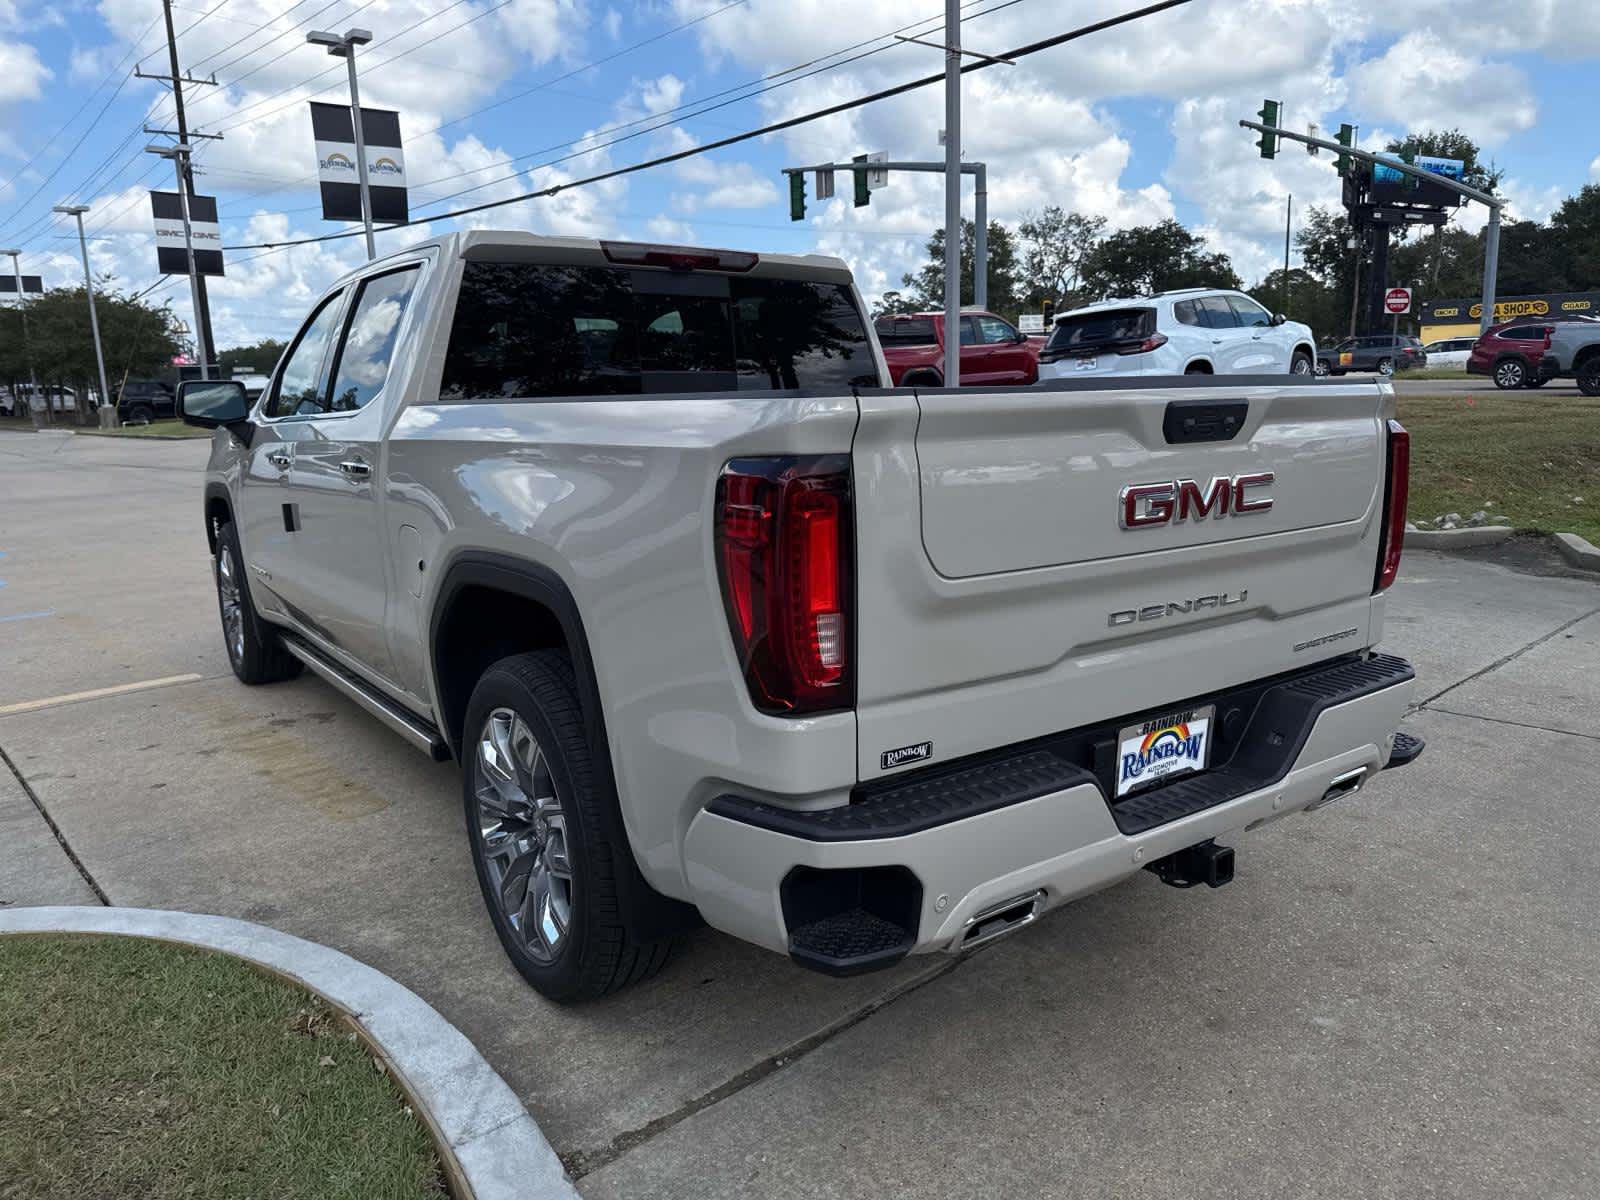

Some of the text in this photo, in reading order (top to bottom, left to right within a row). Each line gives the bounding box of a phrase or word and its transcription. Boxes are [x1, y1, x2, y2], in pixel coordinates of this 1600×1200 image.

[156, 229, 185, 238] GMC
[192, 231, 221, 240] GMC
[1503, 303, 1530, 314] SHOP
[1562, 302, 1590, 310] CIGARS
[1118, 471, 1275, 531] GMC
[1108, 589, 1249, 627] DENALI
[1142, 711, 1194, 734] RAINBOW
[887, 743, 928, 765] RAINBOW
[1121, 732, 1204, 783] RAINBOW
[1147, 759, 1179, 773] AUTOMOTIVE
